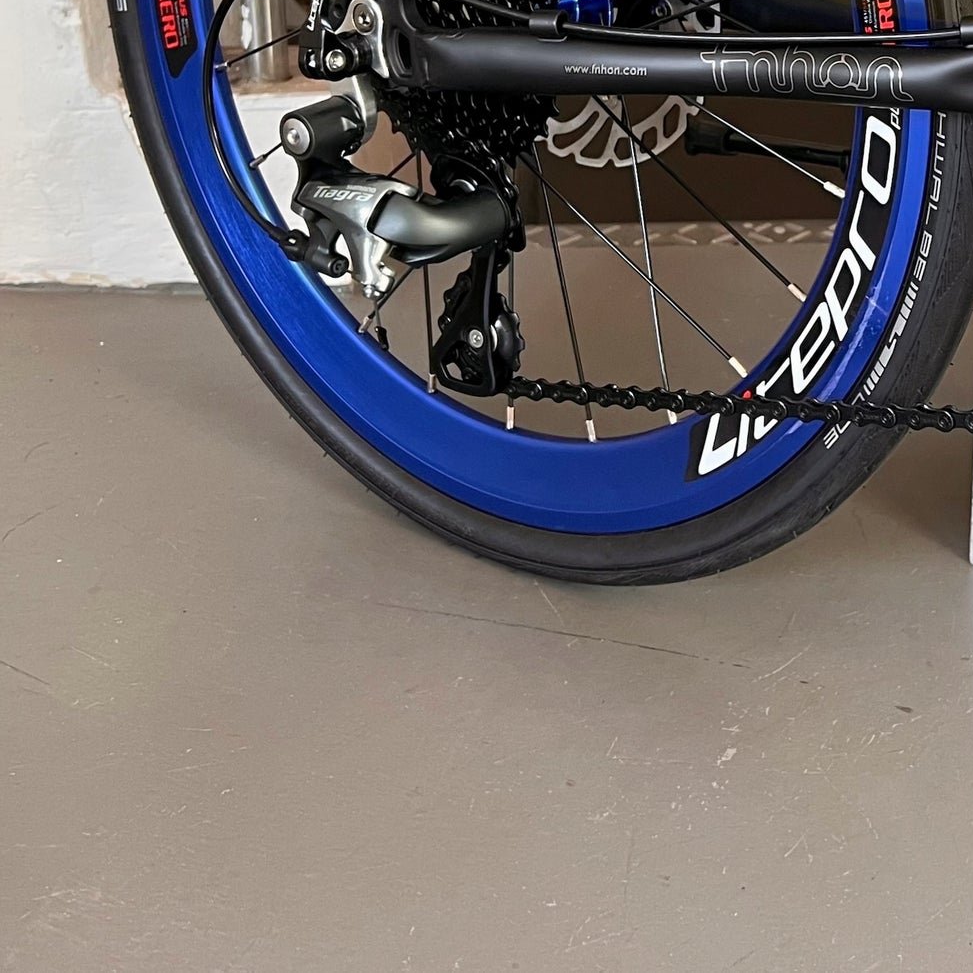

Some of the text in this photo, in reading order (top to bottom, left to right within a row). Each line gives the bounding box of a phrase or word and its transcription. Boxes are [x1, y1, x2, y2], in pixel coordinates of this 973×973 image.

[564, 62, 648, 76] www.fnhon.com
[313, 185, 374, 202] Tiagra
[912, 111, 947, 282] HWALBE
